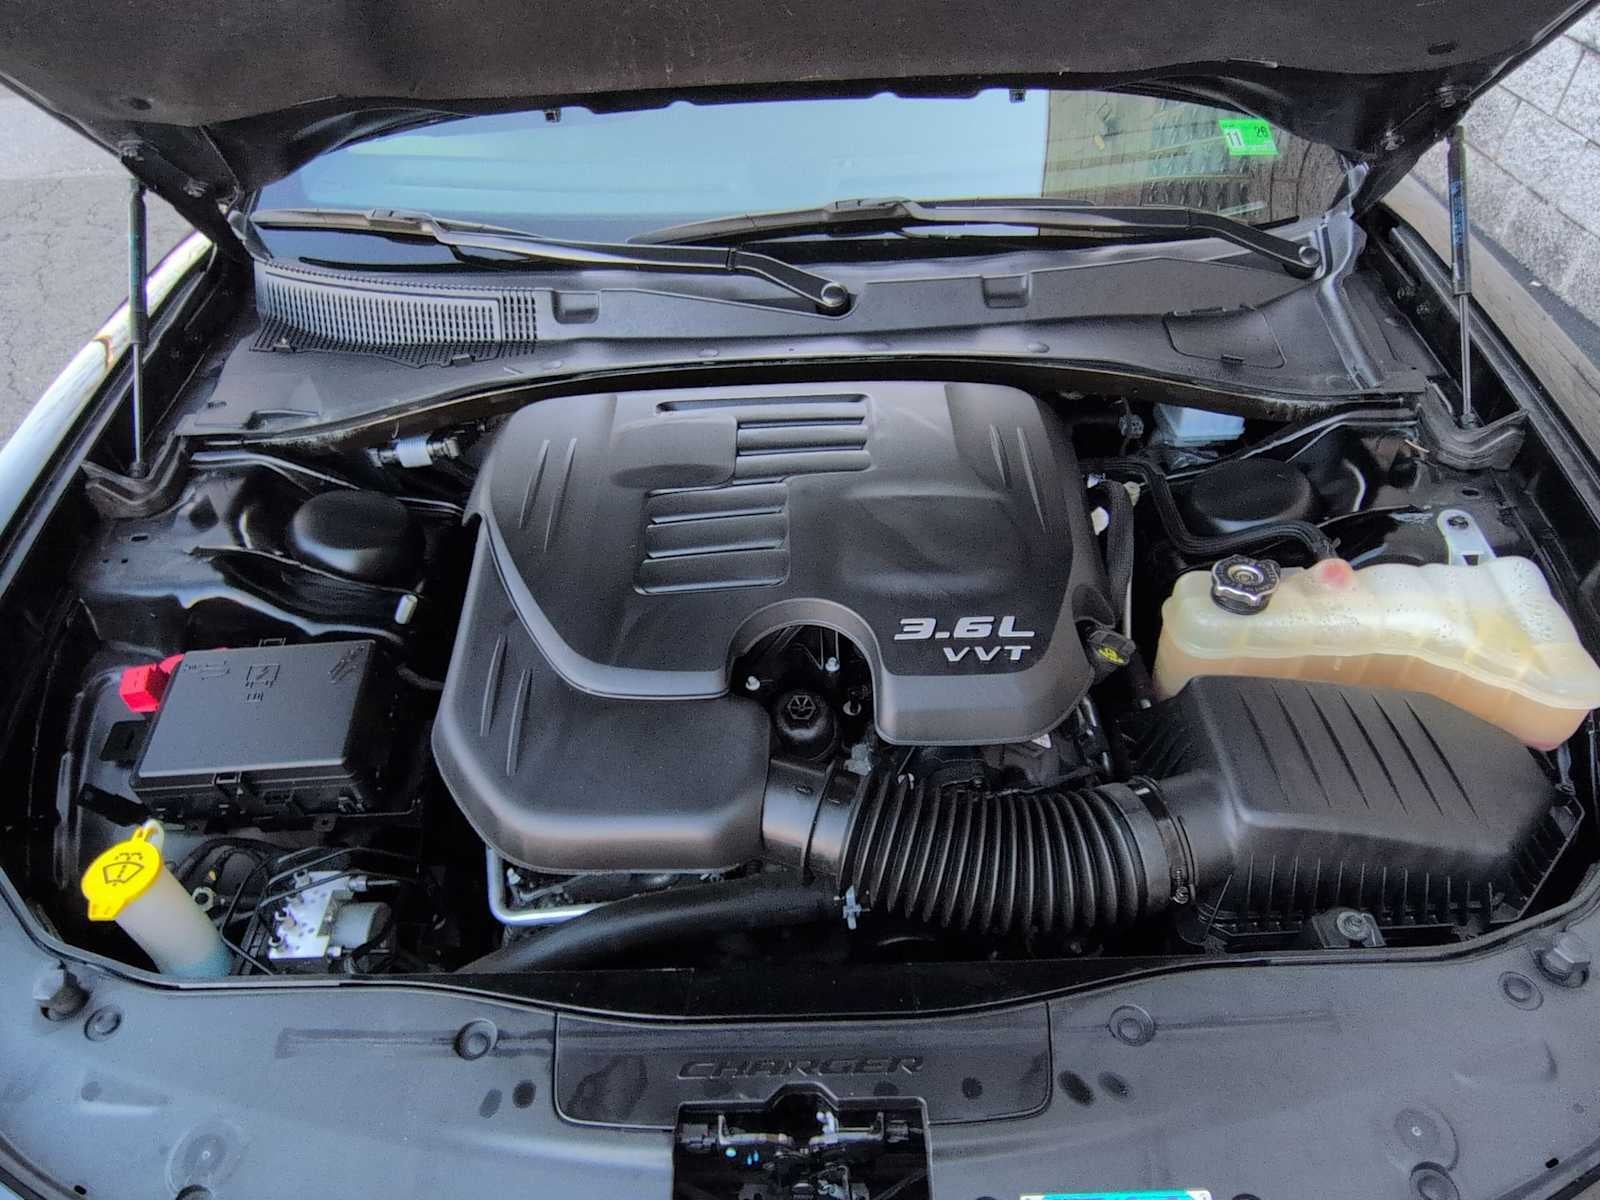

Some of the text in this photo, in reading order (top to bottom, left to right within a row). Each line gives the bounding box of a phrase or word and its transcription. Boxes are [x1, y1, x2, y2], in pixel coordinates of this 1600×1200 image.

[894, 615, 1035, 640] 3.6L
[943, 645, 1031, 662] VVT
[677, 1055, 924, 1080] CHARGER
